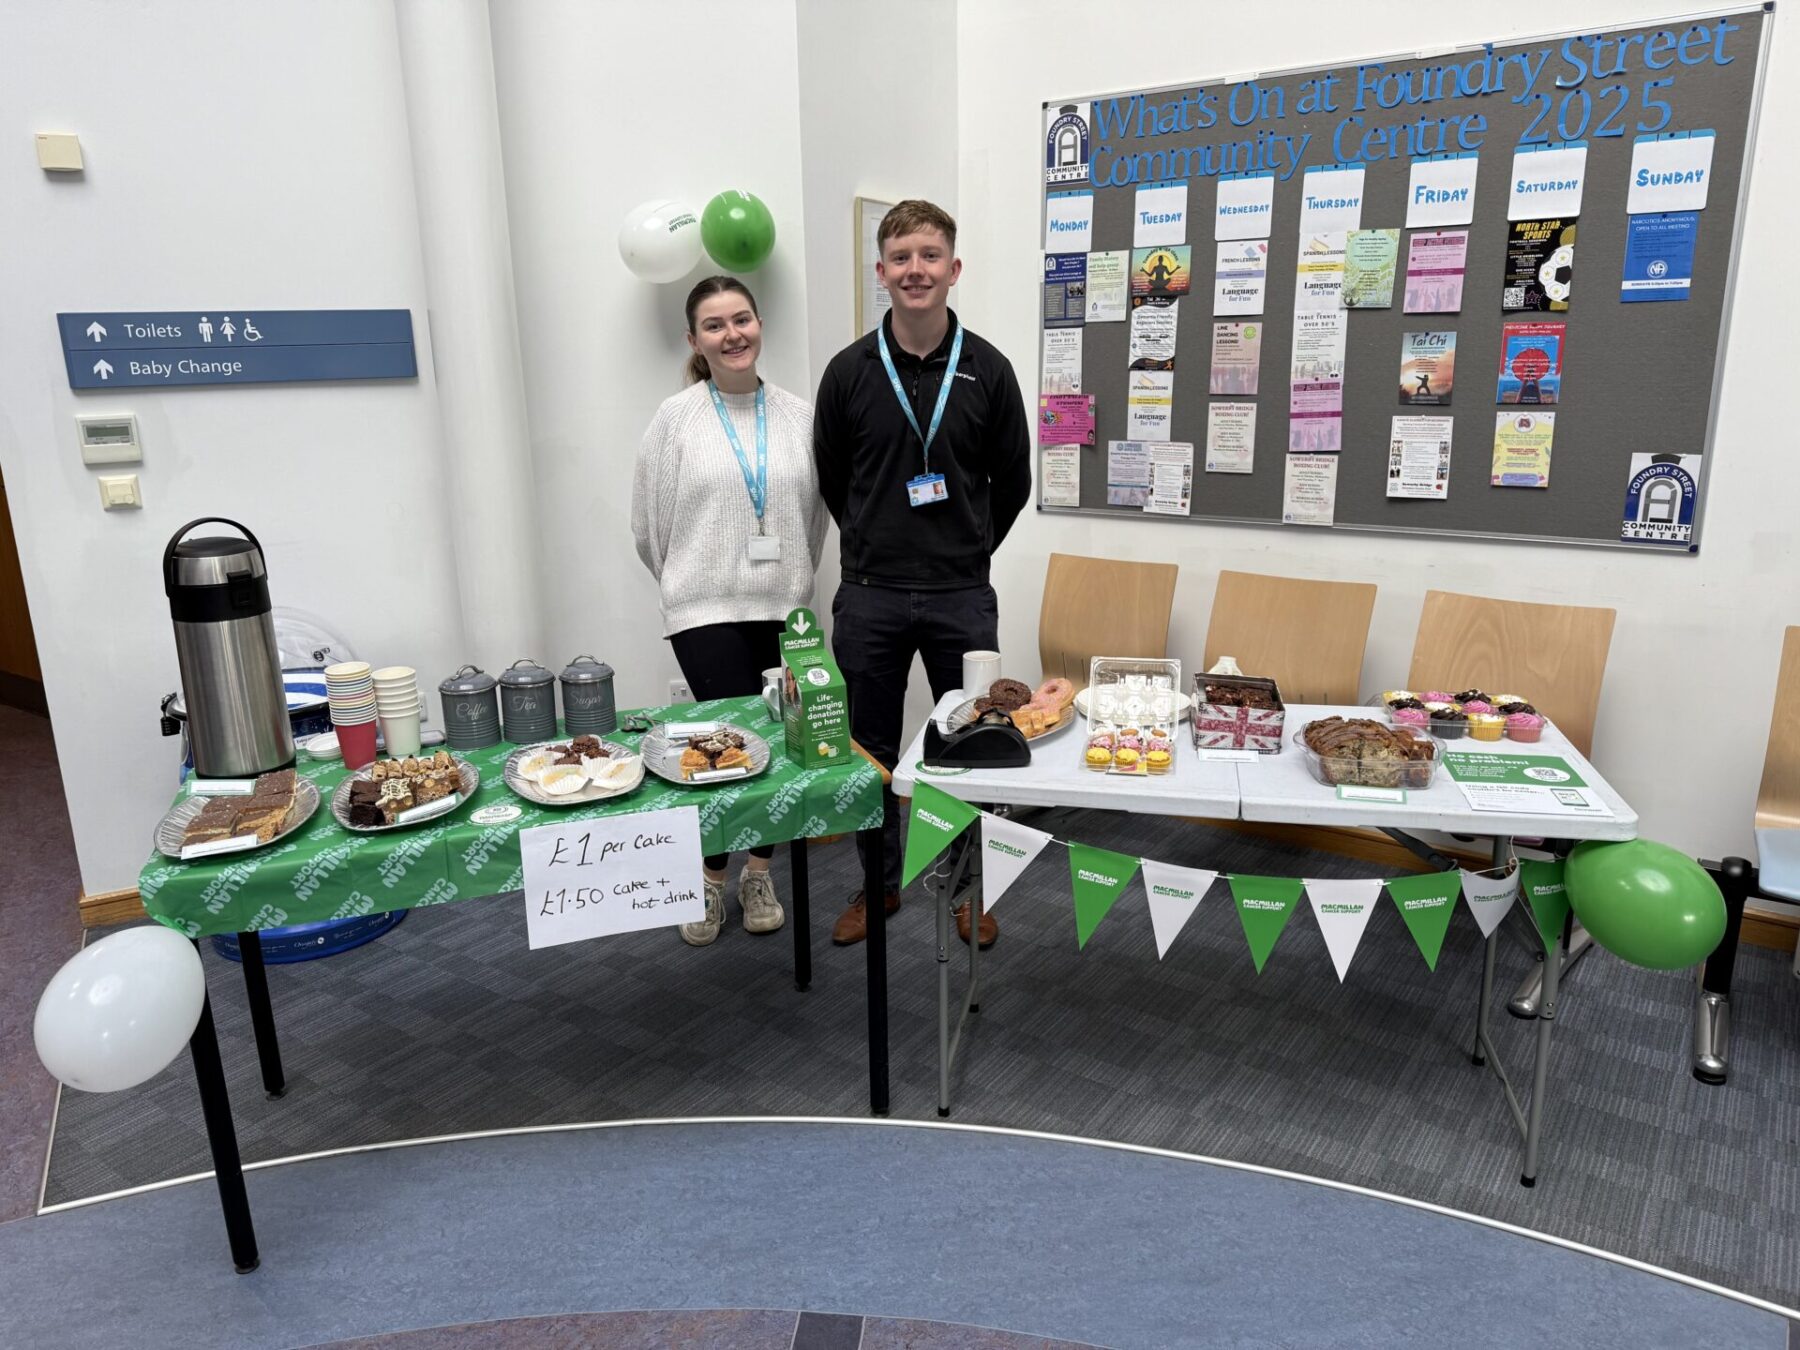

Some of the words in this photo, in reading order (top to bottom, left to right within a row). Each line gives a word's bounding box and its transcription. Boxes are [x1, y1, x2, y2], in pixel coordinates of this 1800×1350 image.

[1093, 90, 1217, 139] What's
[1229, 82, 1285, 126] On
[1296, 75, 1341, 114] at
[1352, 44, 1552, 112] Foundry
[1555, 20, 1740, 89] Street
[1048, 115, 1072, 144] FOUNDRY
[1072, 117, 1088, 141] STREET
[1089, 131, 1312, 188] Community
[1332, 113, 1488, 162] Centre
[1520, 76, 1675, 145] 2025
[1047, 166, 1089, 175] COMMUNITY
[1047, 173, 1089, 182] CENTRE
[1636, 169, 1704, 187] SUNDAY
[1516, 180, 1578, 194] SATURDAY
[1415, 187, 1468, 205] FRIDAY
[1219, 205, 1269, 215] WEDNESDAY
[1306, 197, 1359, 210] THURSDAY
[1140, 212, 1182, 225] TUESDAY
[1050, 220, 1089, 234] MONDAY
[1516, 223, 1540, 232] NORTH
[1541, 221, 1560, 230] STAR
[1523, 231, 1552, 240] SPORTS
[123, 323, 182, 338] Toilets
[1411, 334, 1427, 346] Tai
[1429, 334, 1447, 346] Chi
[130, 360, 171, 378] Baby
[178, 358, 242, 377] Change
[1631, 466, 1670, 494] FOUNDRY
[1671, 468, 1692, 498] STREET
[1623, 522, 1691, 532] COMMUNITY
[1621, 530, 1691, 540] CENTRE
[512, 695, 537, 711] Tea
[570, 690, 602, 709] Sugar
[816, 693, 833, 703] Life-
[456, 702, 488, 721] Coffee
[808, 701, 843, 713] changing
[807, 708, 844, 721] donations
[813, 721, 823, 729] go
[824, 718, 841, 726] here
[917, 808, 954, 830] MACMILLAN
[600, 841, 626, 862] per
[988, 839, 1027, 855] MACMILLAN
[656, 878, 671, 887] +
[1078, 869, 1118, 884] MACMILLAN
[1153, 884, 1194, 897] MACMILLAN
[1534, 882, 1566, 893] MACMILL
[632, 898, 661, 910] hot
[663, 890, 698, 905] drink
[1404, 896, 1447, 907] MACMILLAN
[1473, 889, 1515, 901] MACMILLAN
[1243, 899, 1285, 908] MACMILLAN
